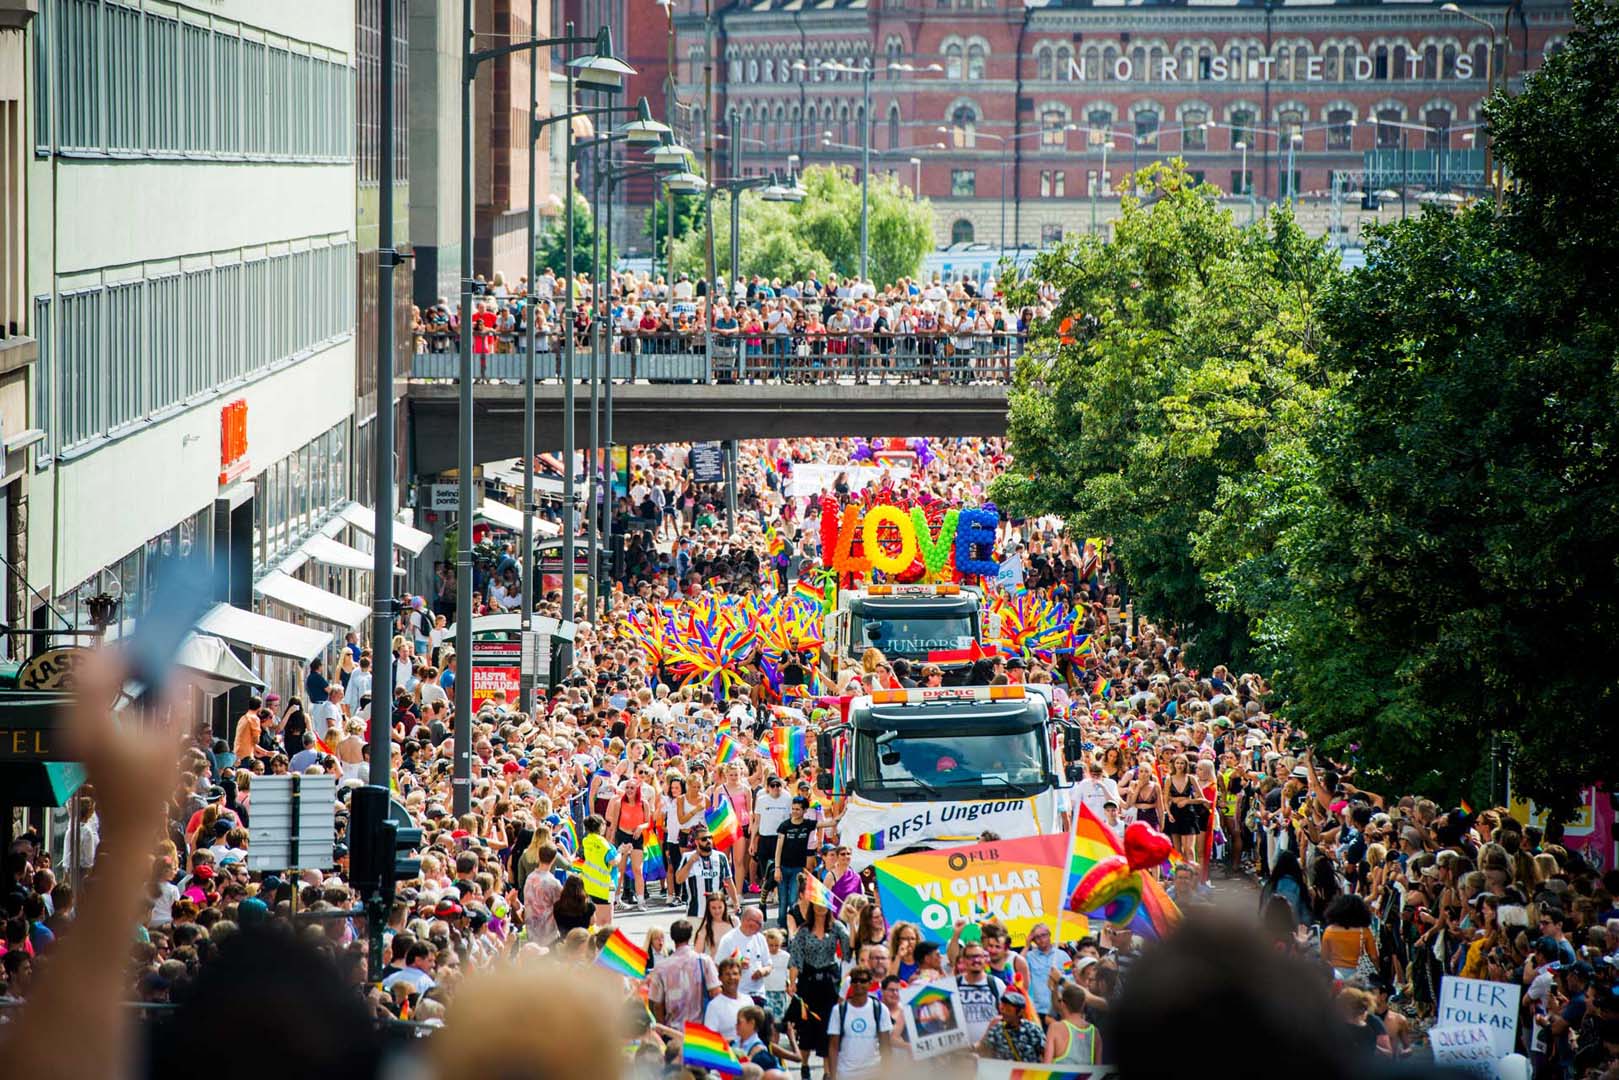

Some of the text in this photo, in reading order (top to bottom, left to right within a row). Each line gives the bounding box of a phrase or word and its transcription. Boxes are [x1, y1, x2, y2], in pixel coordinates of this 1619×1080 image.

[1067, 56, 1473, 81] NORSTEDTS
[884, 639, 960, 652] JUNIORS
[473, 681, 520, 690] DATADEA
[473, 690, 494, 699] EVE
[888, 799, 1024, 842] RFSL Ungdom
[969, 849, 999, 863] FUB
[915, 869, 1041, 902] VI GILLAR
[959, 991, 993, 1004] UCK
[1453, 982, 1507, 1008] FLER
[1446, 1007, 1513, 1030] TOLKAR
